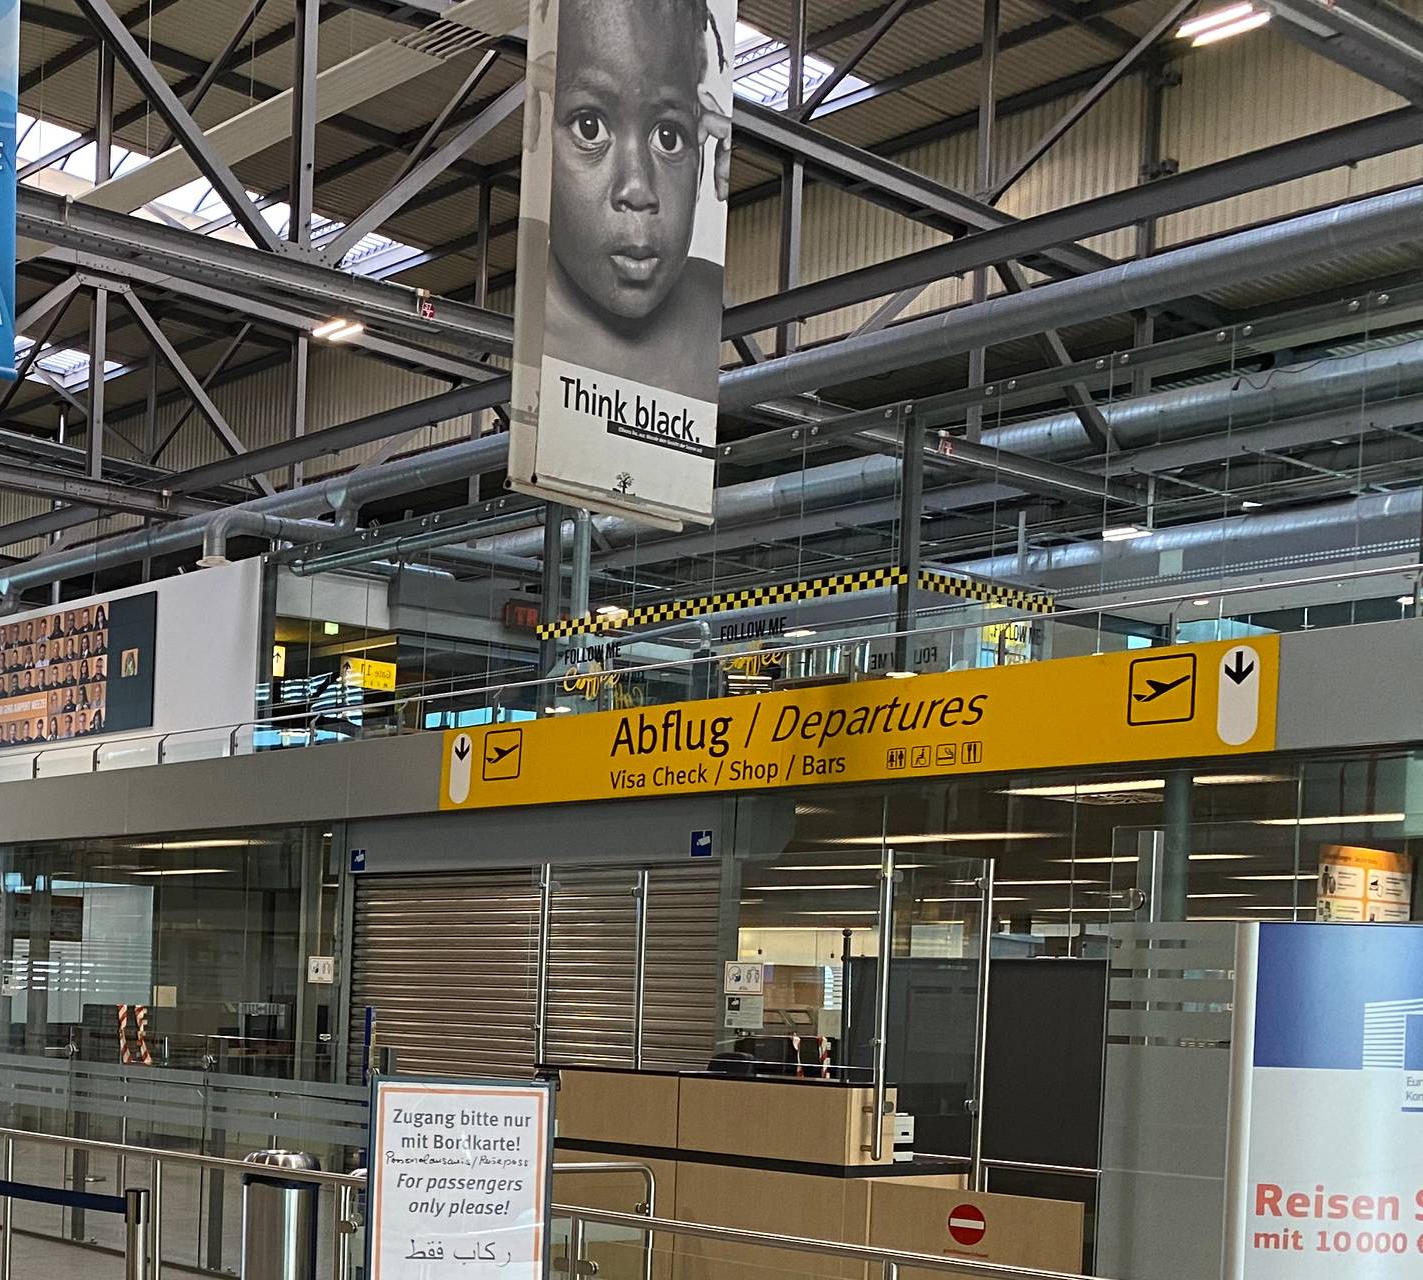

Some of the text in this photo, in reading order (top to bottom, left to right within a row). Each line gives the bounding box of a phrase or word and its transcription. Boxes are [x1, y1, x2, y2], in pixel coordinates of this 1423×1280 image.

[560, 376, 628, 424] Think
[635, 395, 700, 444] black.
[720, 616, 788, 643] FOLLOW ME
[564, 641, 622, 665] FOLLOW ME
[610, 692, 989, 758] Abflug / Departures
[610, 754, 846, 790] Visa Check / Shop / Bars
[393, 1108, 532, 1130] Zugang bitte nur
[401, 1133, 520, 1152] mit Bordkarte!
[396, 1173, 523, 1195] For passengers
[408, 1198, 510, 1218] only please!
[1255, 1183, 1400, 1221] Reisen
[1254, 1228, 1304, 1251] mit
[405, 1238, 511, 1267] ركاب فقط
